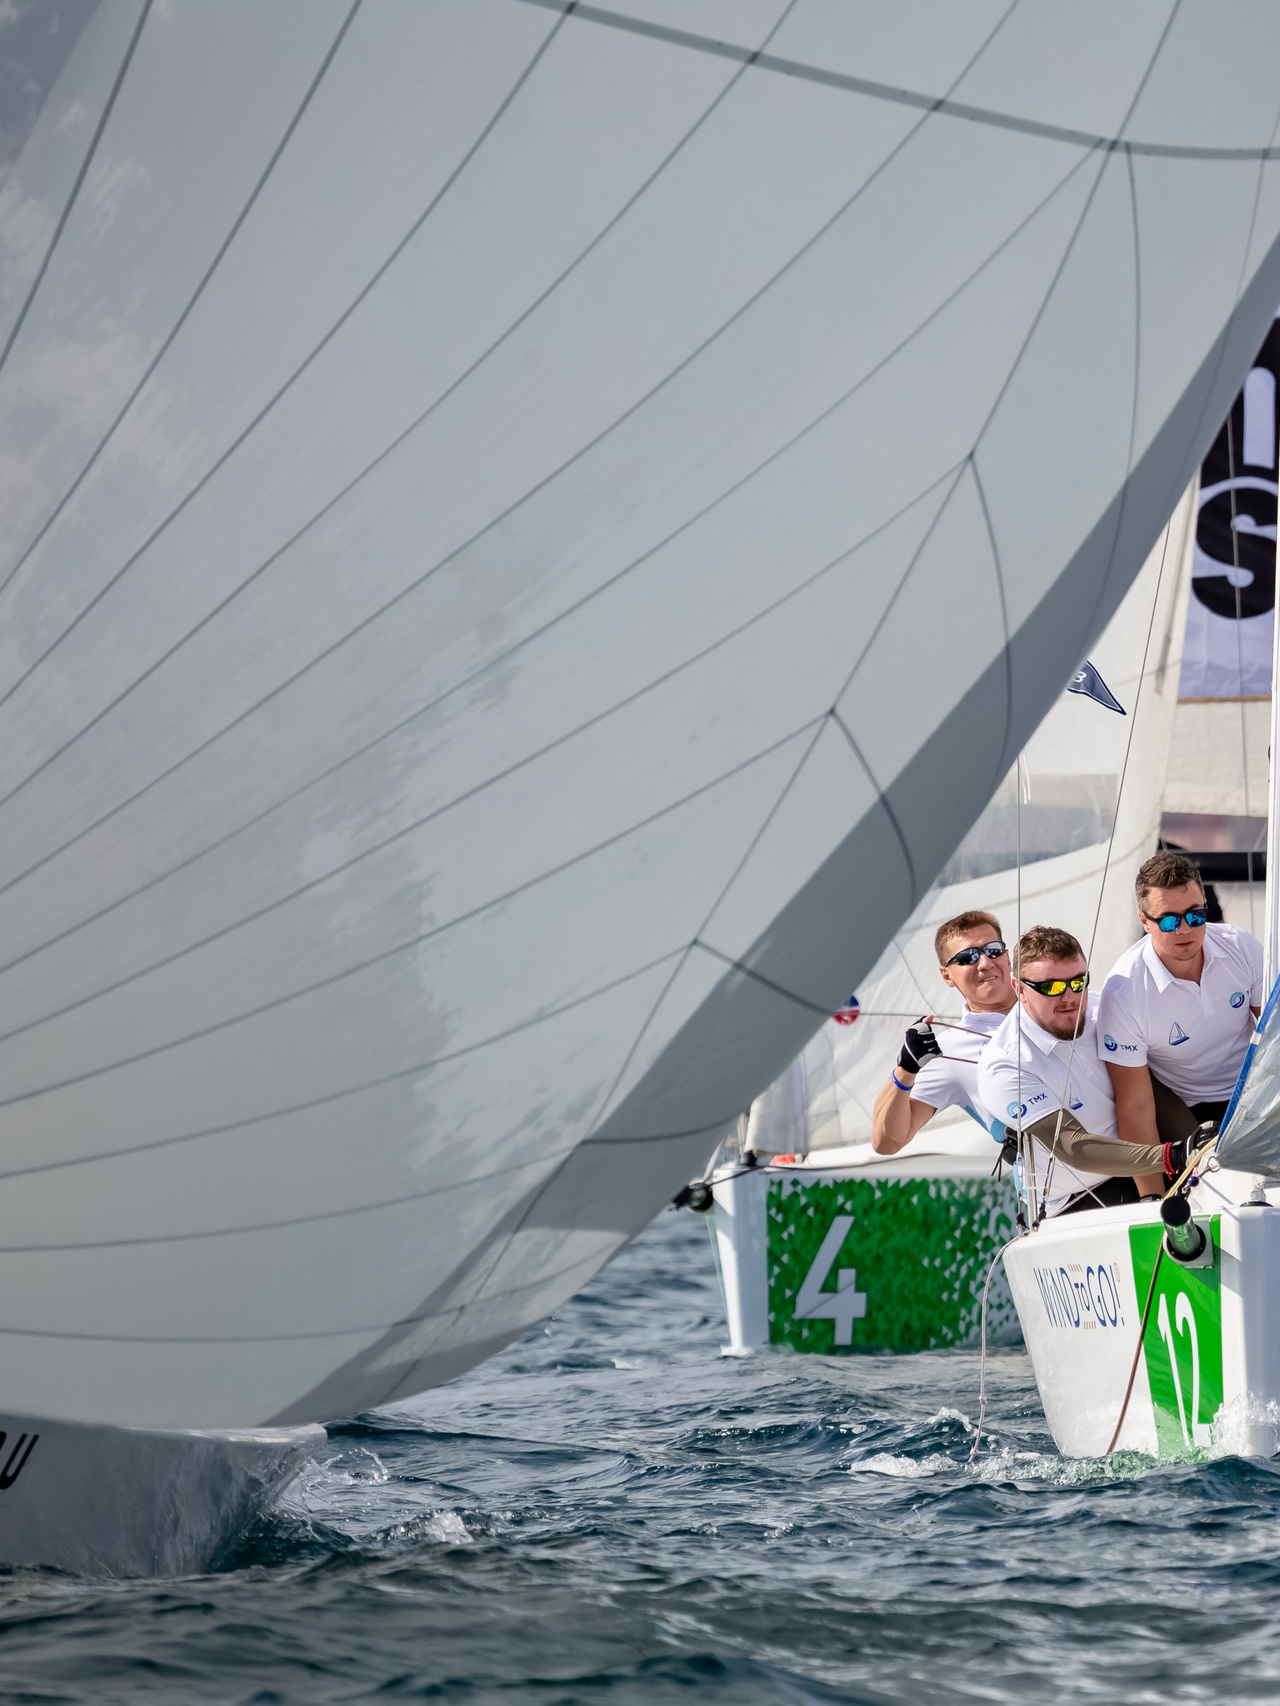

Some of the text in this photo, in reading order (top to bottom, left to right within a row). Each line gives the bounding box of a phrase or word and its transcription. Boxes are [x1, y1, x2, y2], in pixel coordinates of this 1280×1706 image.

[1120, 1044, 1139, 1052] TMX
[1027, 1092, 1048, 1105] TMX
[794, 1215, 867, 1346] 4
[1157, 1291, 1213, 1449] 12
